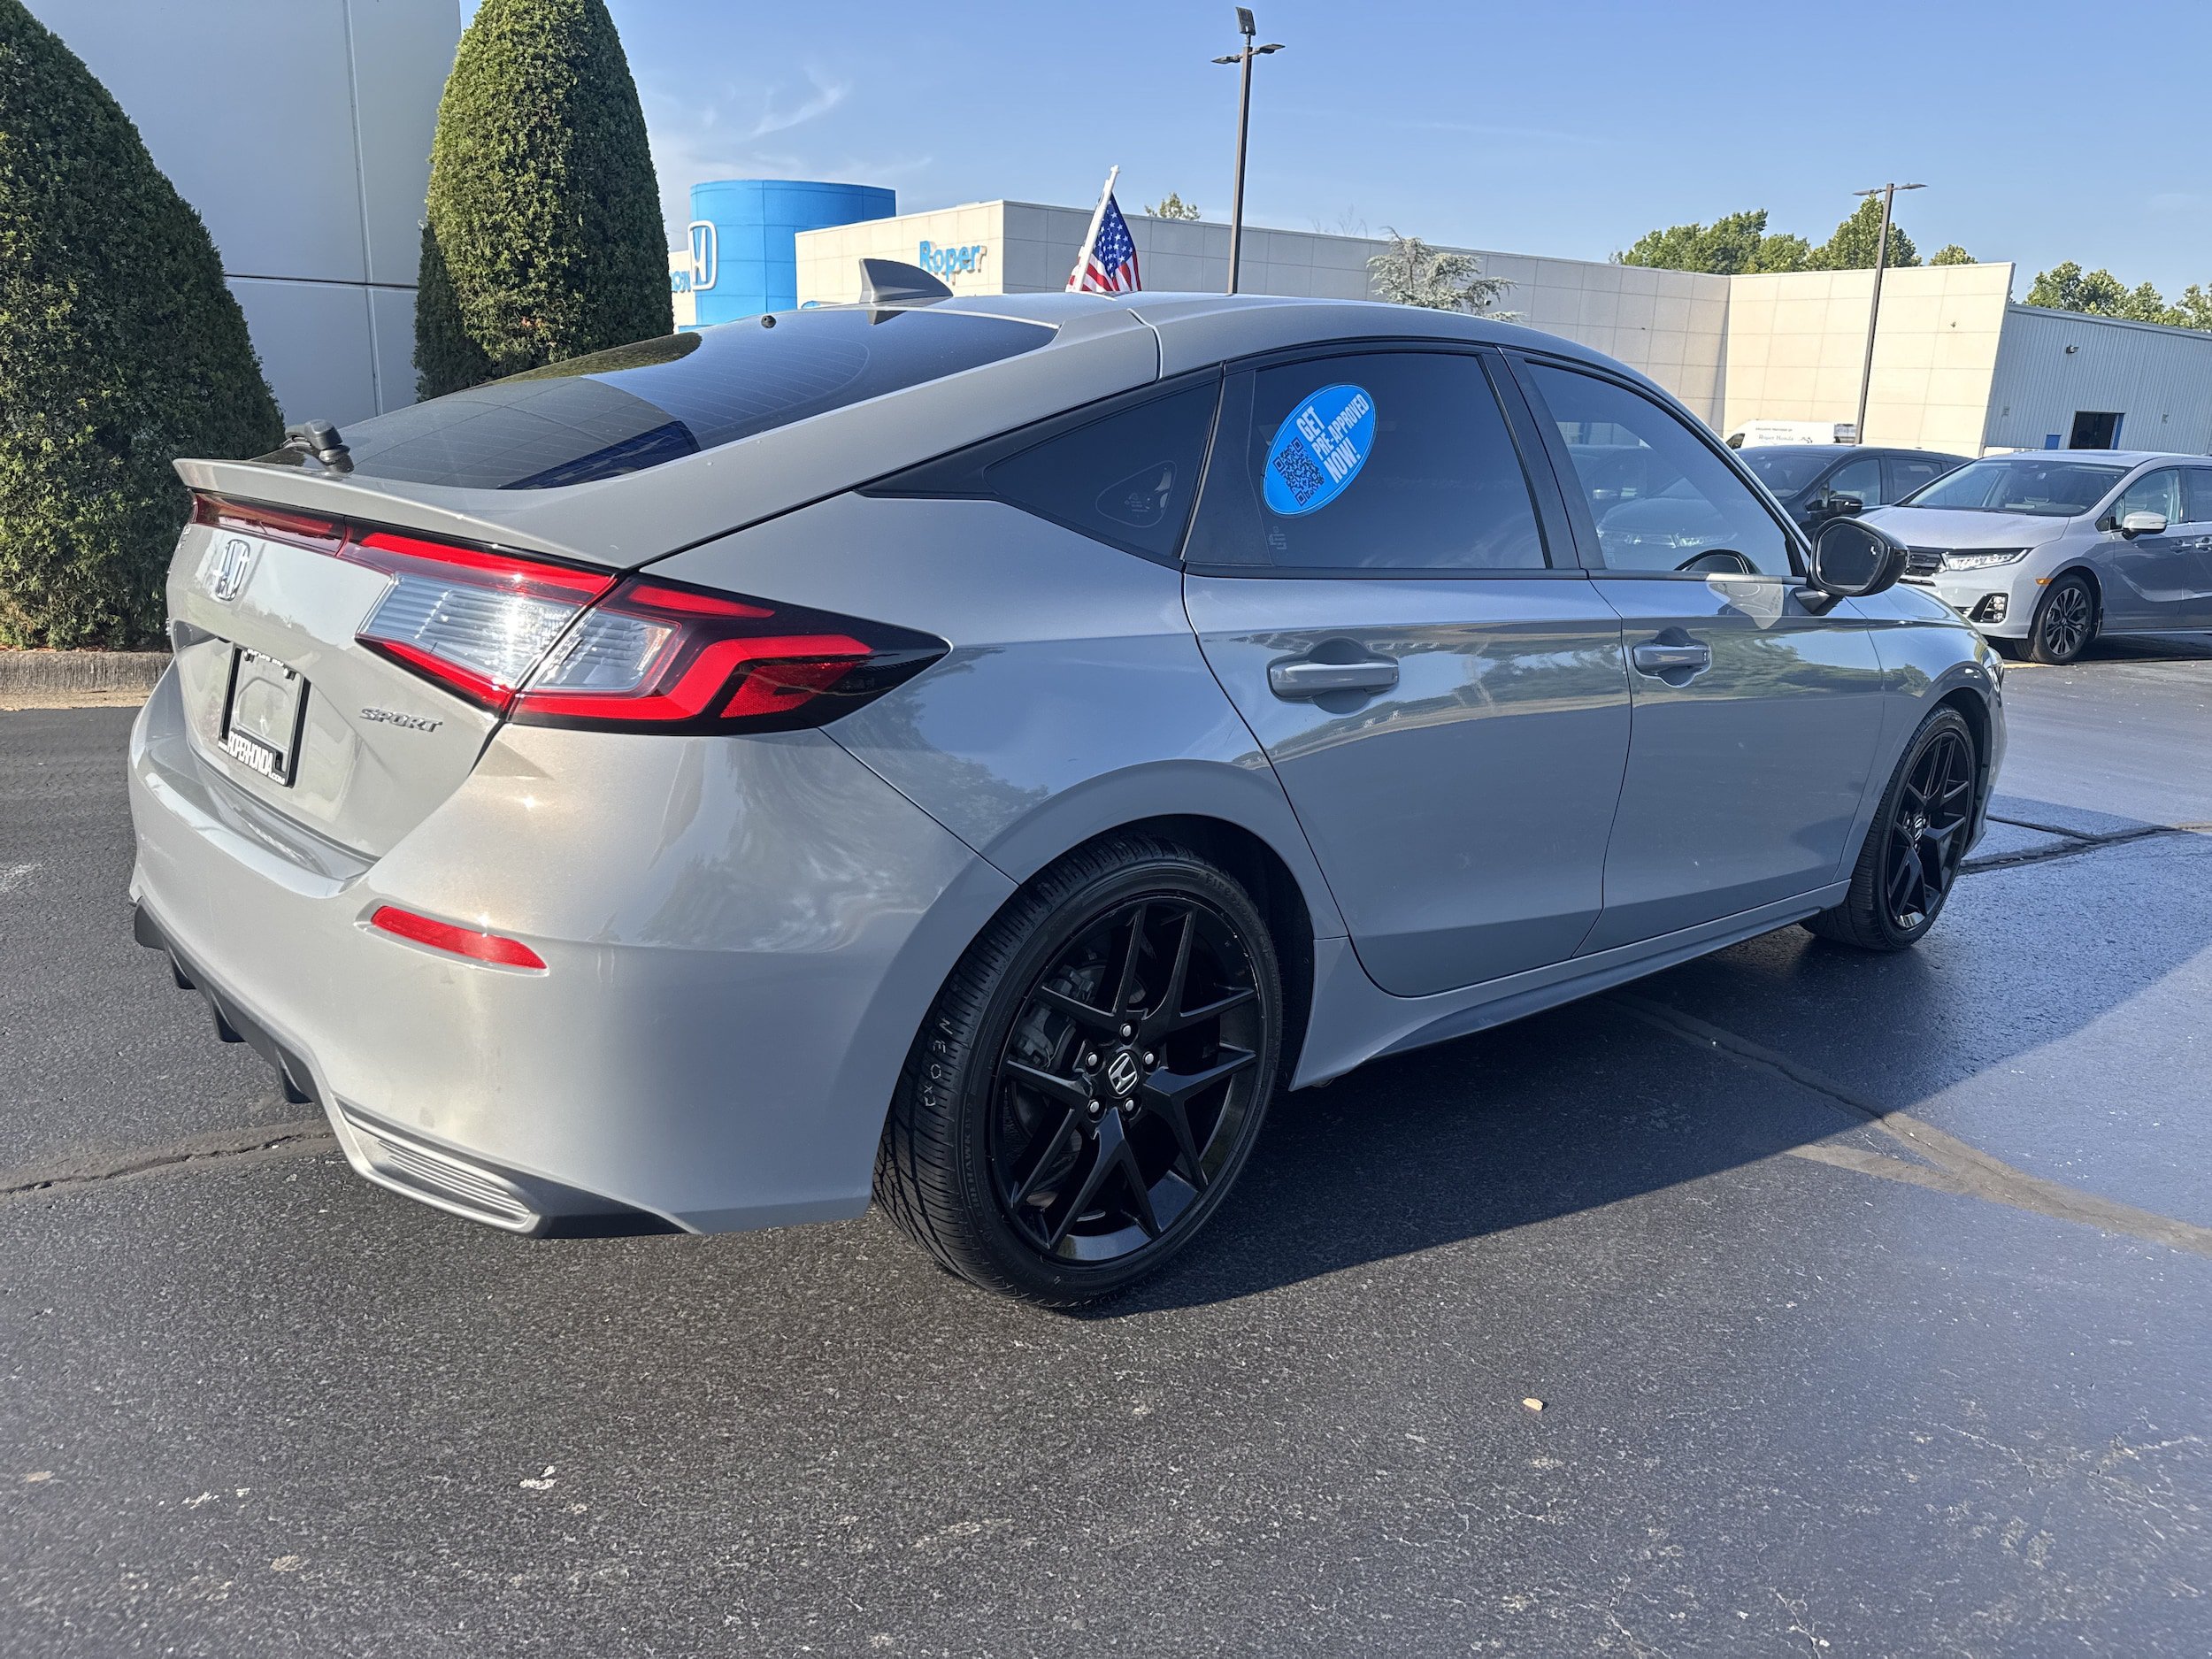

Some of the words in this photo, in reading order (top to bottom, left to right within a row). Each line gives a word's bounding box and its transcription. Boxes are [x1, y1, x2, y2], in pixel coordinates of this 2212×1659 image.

[919, 240, 984, 283] Roper
[1296, 405, 1325, 442] GET
[1311, 393, 1370, 461] PRE-APPROVED
[1323, 437, 1362, 484] NOW!
[358, 708, 443, 733] SPORT
